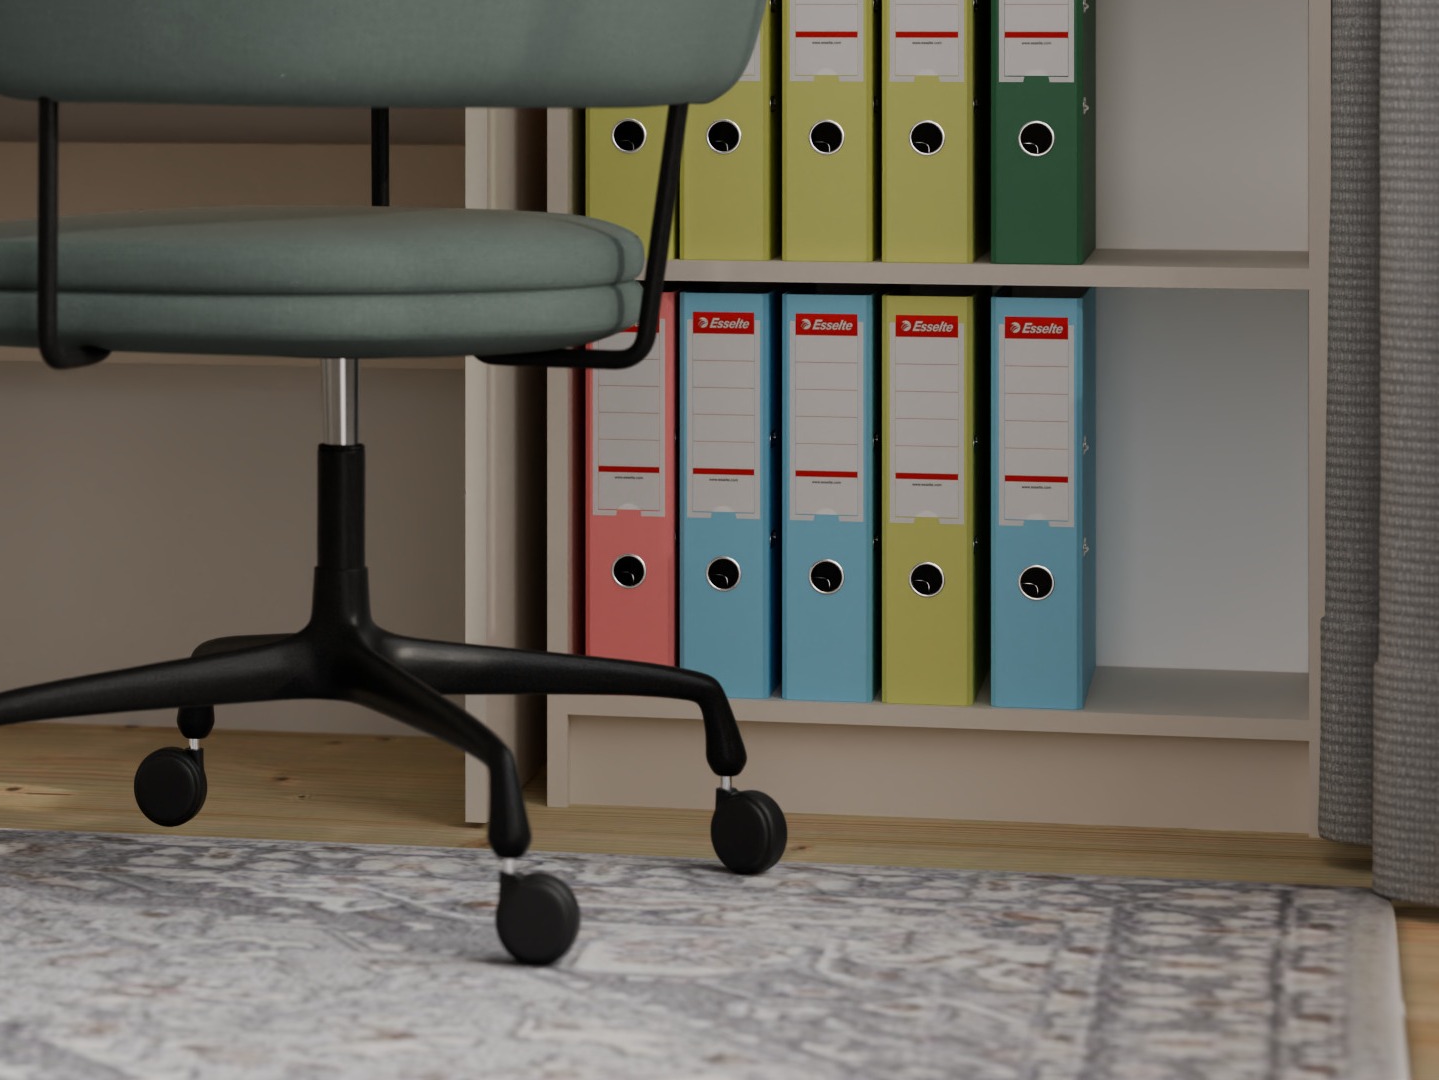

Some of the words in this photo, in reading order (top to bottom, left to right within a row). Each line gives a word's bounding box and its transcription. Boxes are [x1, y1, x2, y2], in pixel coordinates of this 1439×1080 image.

[709, 317, 750, 329] Esselte
[812, 318, 853, 331] Esselte
[912, 320, 954, 333] Esselte
[1022, 322, 1064, 334] Esselte
